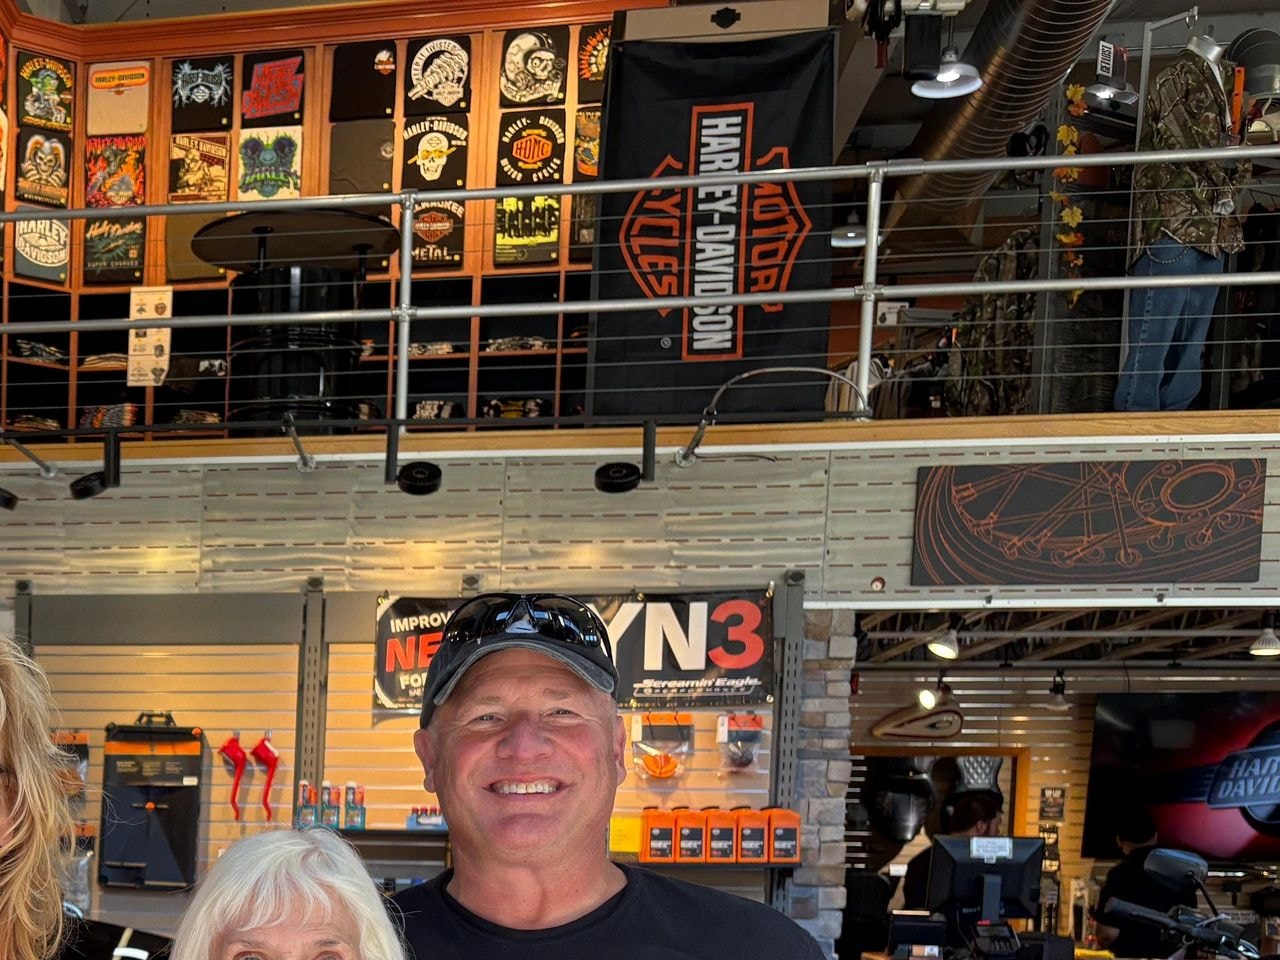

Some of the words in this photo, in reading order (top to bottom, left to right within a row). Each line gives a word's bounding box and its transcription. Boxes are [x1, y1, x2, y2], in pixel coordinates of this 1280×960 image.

[19, 219, 67, 246] HARLEY
[692, 116, 742, 349] HAREY-DAVIDSON
[390, 611, 455, 633] IMPROV
[586, 600, 765, 671] YN3
[385, 631, 443, 673] NE
[400, 673, 428, 689] FO
